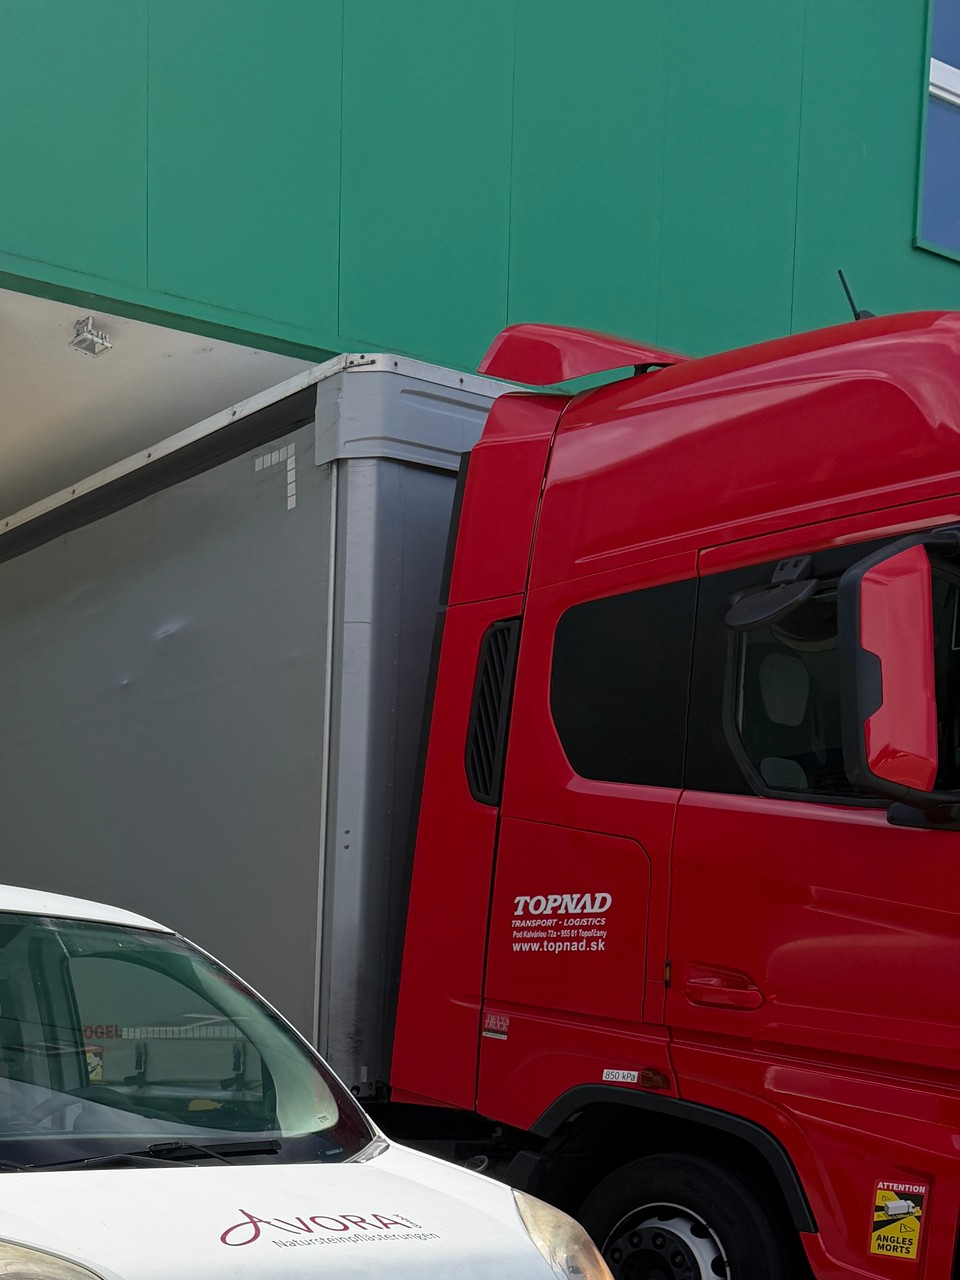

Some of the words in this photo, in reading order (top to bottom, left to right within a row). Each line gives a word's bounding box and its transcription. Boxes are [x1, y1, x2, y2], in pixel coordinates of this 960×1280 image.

[514, 892, 612, 915] TOPNAD
[512, 918, 558, 927] TRANSPORT
[563, 917, 606, 926] LOGISTICS
[512, 930, 522, 938] Pod
[547, 930, 557, 938] 72a
[512, 938, 605, 954] www.topnad.sk
[82, 1024, 122, 1040] ÖGEL
[604, 1071, 620, 1080] 850
[622, 1072, 635, 1081] kPa
[877, 1181, 926, 1193] ATTENTION
[272, 1231, 441, 1249] Natursteinpflästerungen
[876, 1234, 913, 1246] ANGLES
[877, 1243, 911, 1254] MORTS
